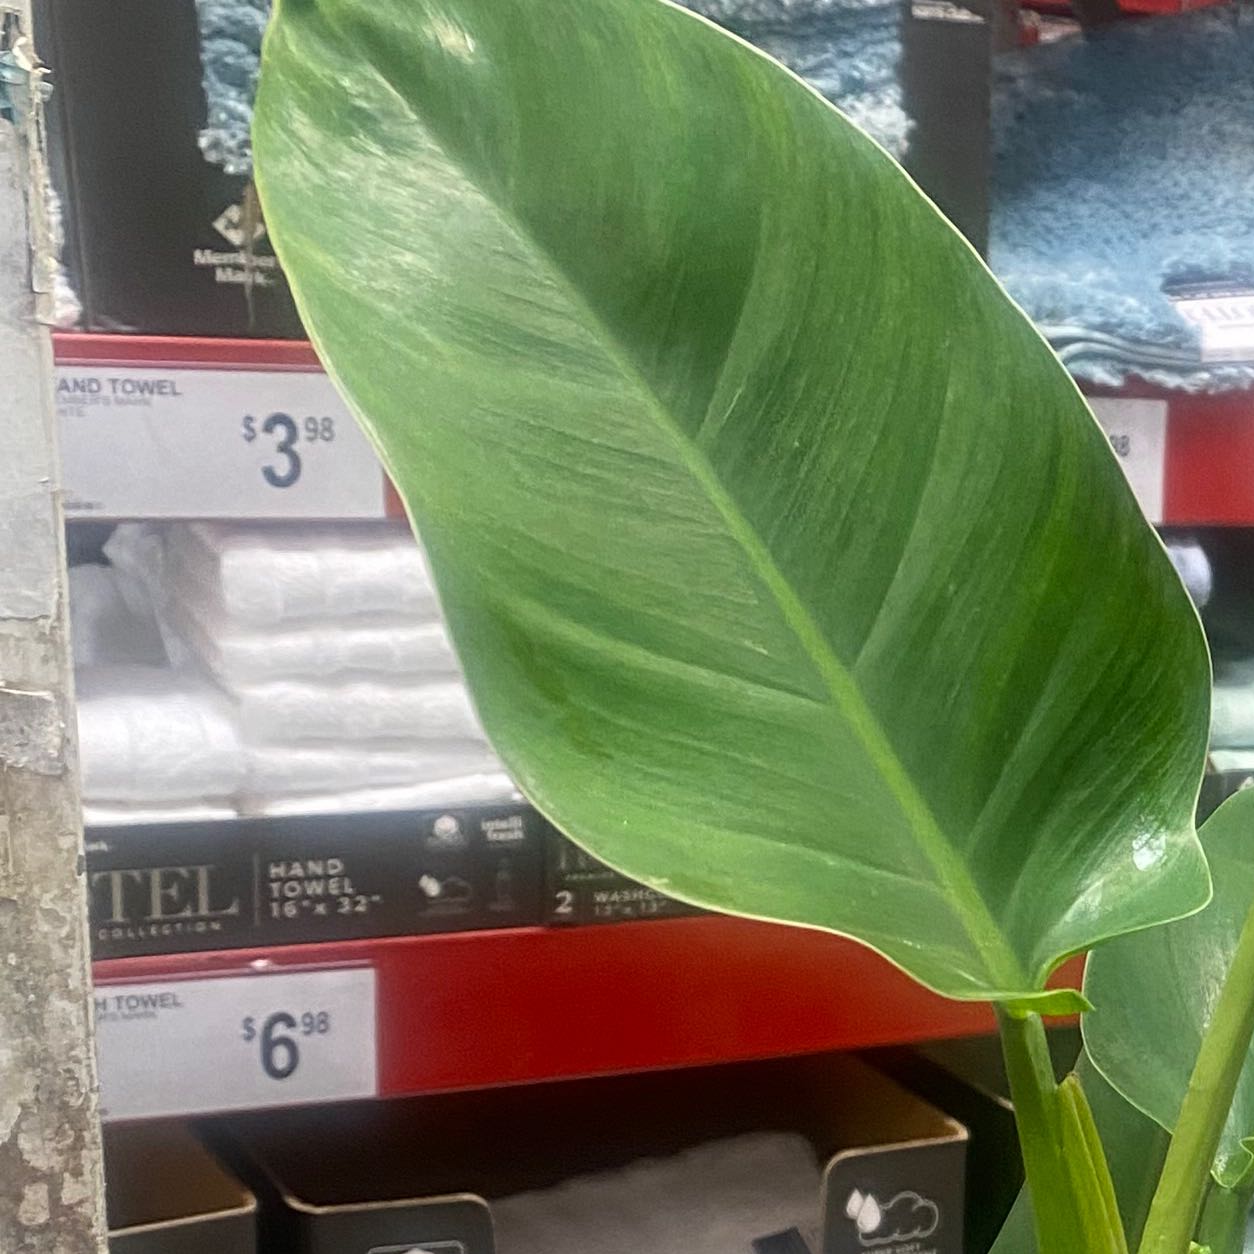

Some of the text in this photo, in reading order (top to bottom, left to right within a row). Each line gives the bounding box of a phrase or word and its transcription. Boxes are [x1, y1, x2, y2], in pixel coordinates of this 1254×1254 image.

[57, 378, 182, 397] AND TOWEL
[269, 858, 345, 879] HAND
[90, 865, 240, 922] TEL
[269, 876, 356, 898] TOWEL
[554, 890, 573, 914] 2
[97, 921, 221, 941] COLLECTION
[94, 992, 184, 1011] H TOWEL
